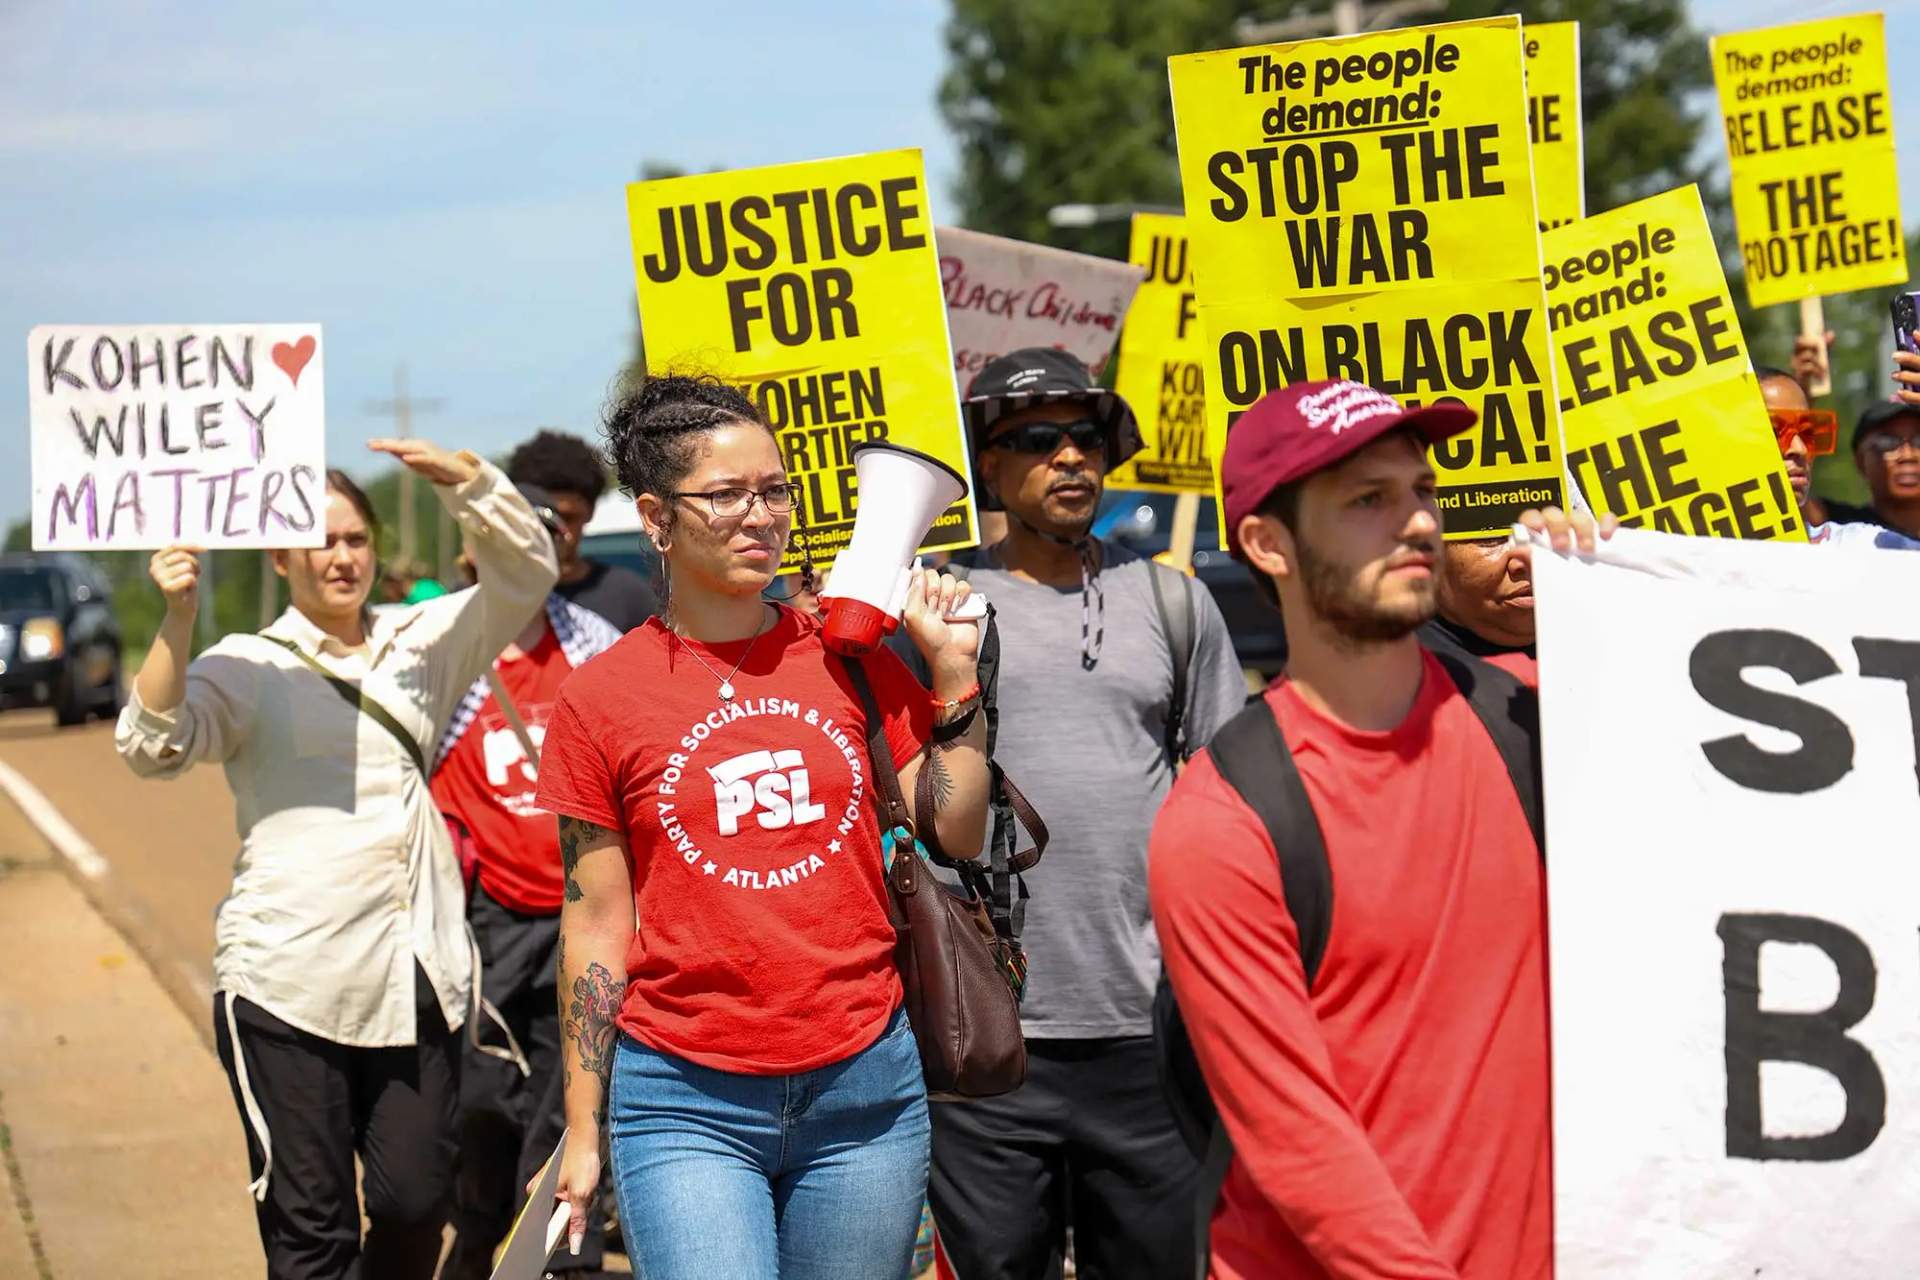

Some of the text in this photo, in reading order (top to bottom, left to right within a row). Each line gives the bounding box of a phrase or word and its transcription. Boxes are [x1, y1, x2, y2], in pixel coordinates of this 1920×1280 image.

[1239, 34, 1460, 97] The people
[1725, 32, 1862, 74] The people
[1736, 64, 1852, 102] demand:
[1262, 81, 1442, 136] demand:
[1726, 92, 1887, 157] RELEASE
[1207, 124, 1505, 222] STOP THE
[1759, 171, 1847, 232] THE
[643, 176, 926, 283] JUSTICE
[1284, 209, 1434, 289] WAR
[726, 267, 860, 353] FOR
[1548, 266, 1667, 332] mand:
[43, 334, 254, 394] KOHEN
[1219, 327, 1308, 406] ON
[1322, 308, 1541, 395] BLACK
[1560, 295, 1740, 413] EASE
[70, 396, 276, 464] WILEY
[745, 366, 887, 432] OHEN
[49, 464, 316, 543] MATTERS
[1465, 488, 1552, 507] Liberation
[1567, 419, 1701, 521] THE
[657, 697, 864, 864] PARTY FOR SOCIALISM & LIBERATION
[713, 767, 826, 837] PSL
[723, 853, 826, 889] ATLANTA
